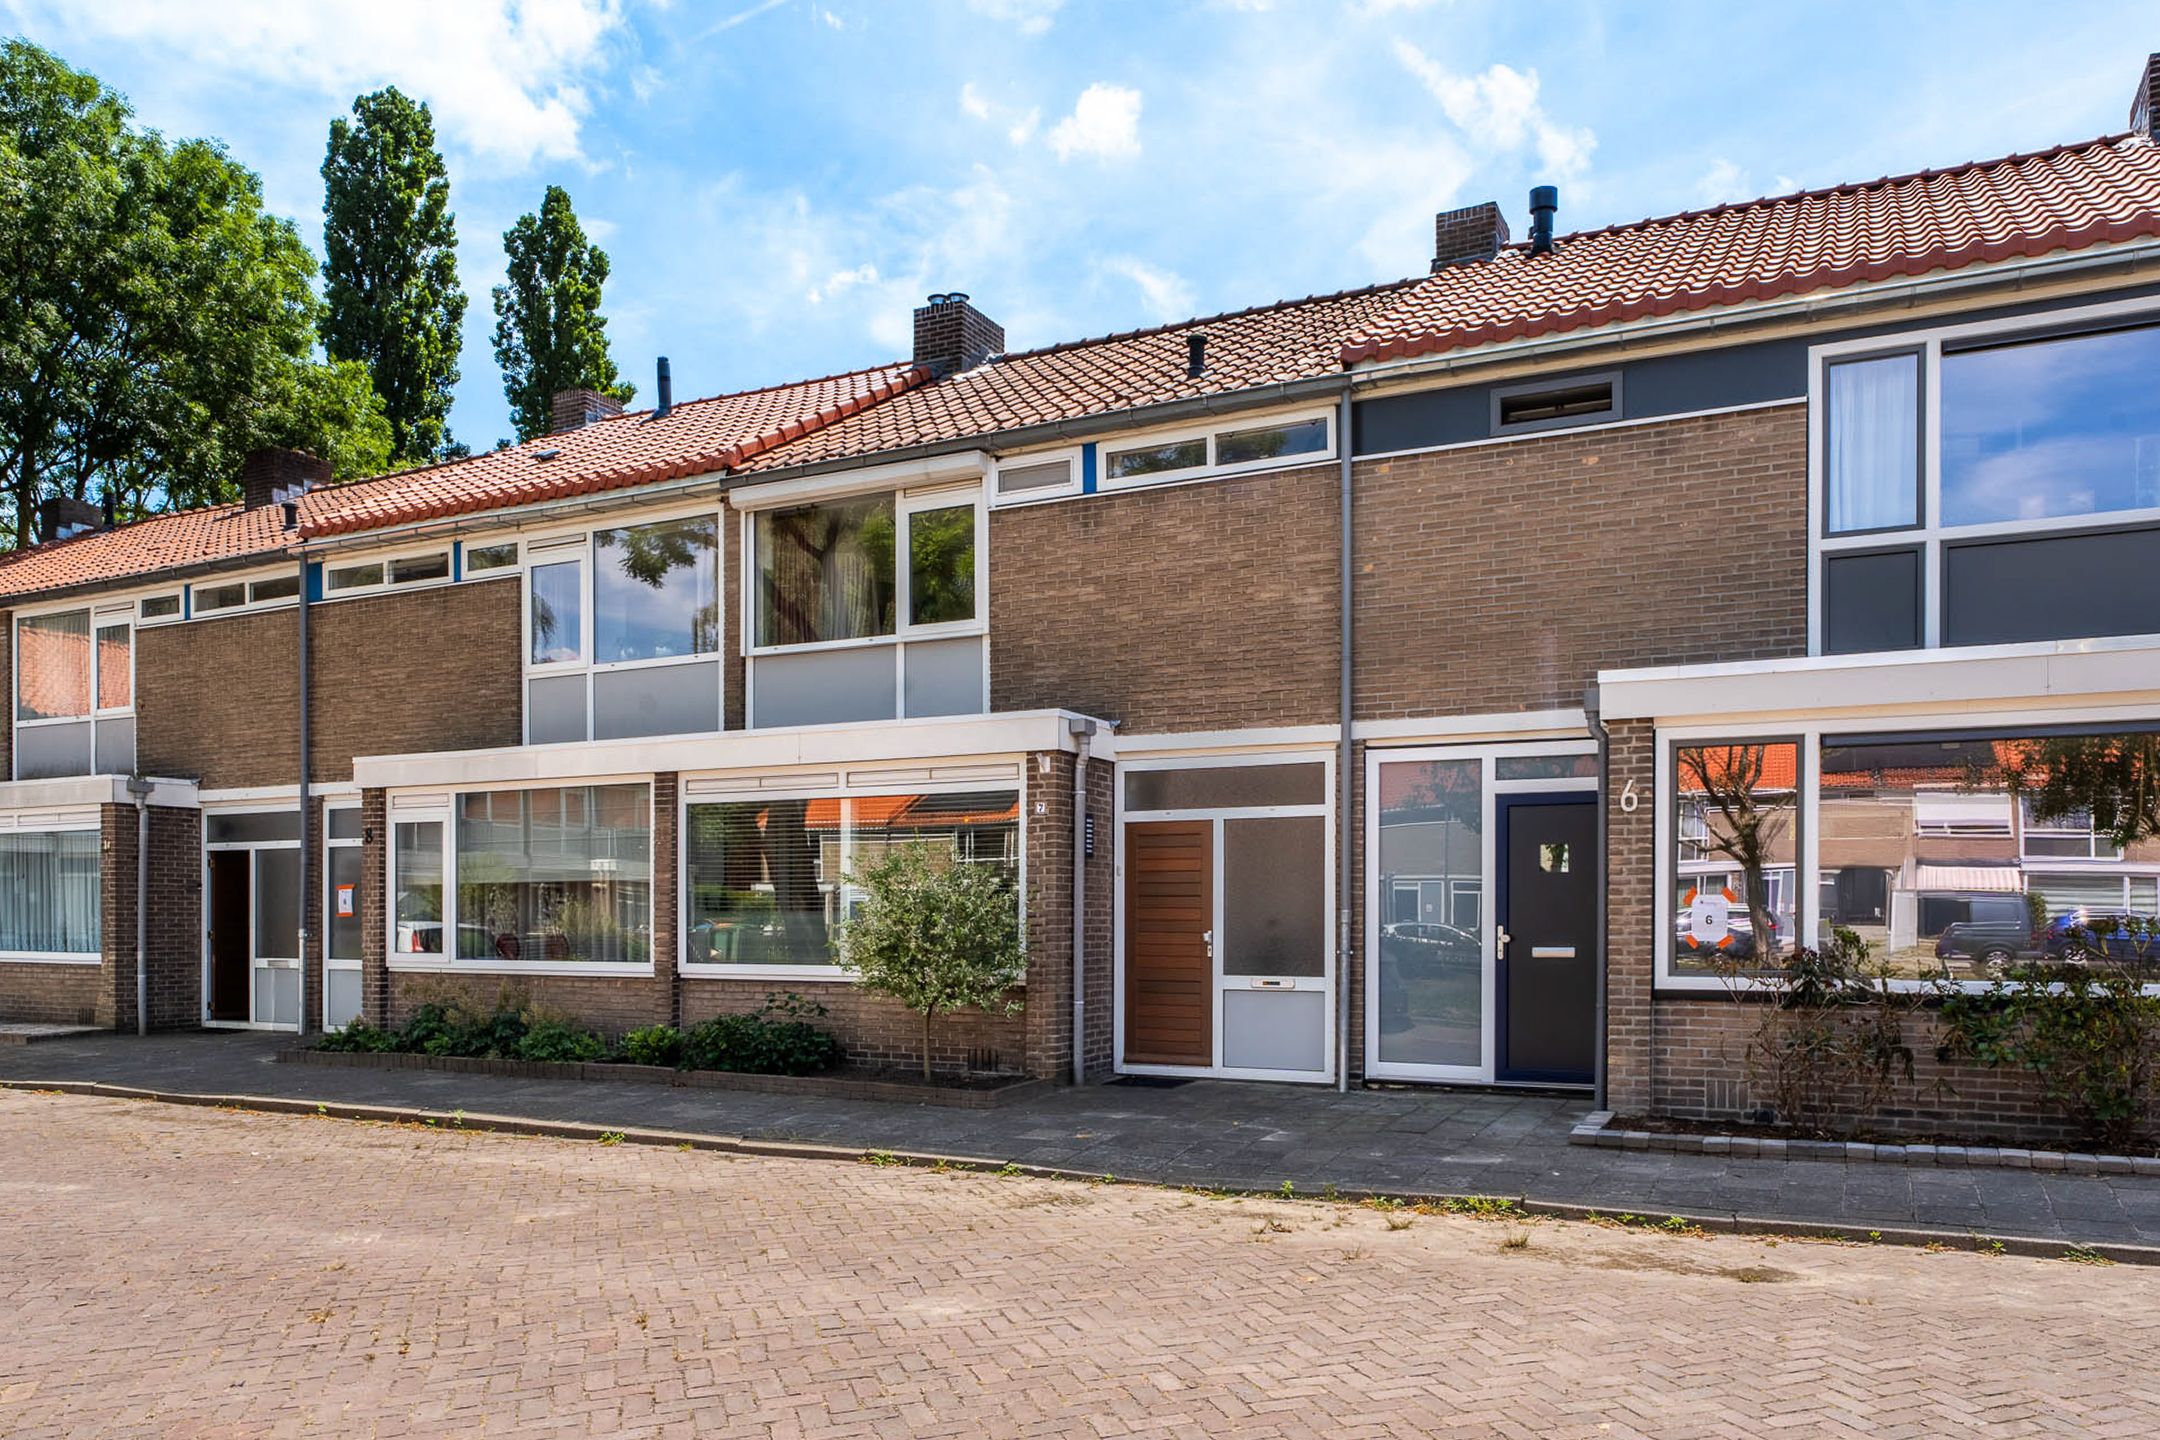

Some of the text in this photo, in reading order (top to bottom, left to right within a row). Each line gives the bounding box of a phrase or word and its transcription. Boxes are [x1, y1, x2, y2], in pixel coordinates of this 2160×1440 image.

[1621, 779, 1638, 812] 6
[365, 827, 373, 844] 8
[1705, 914, 1713, 925] 6
